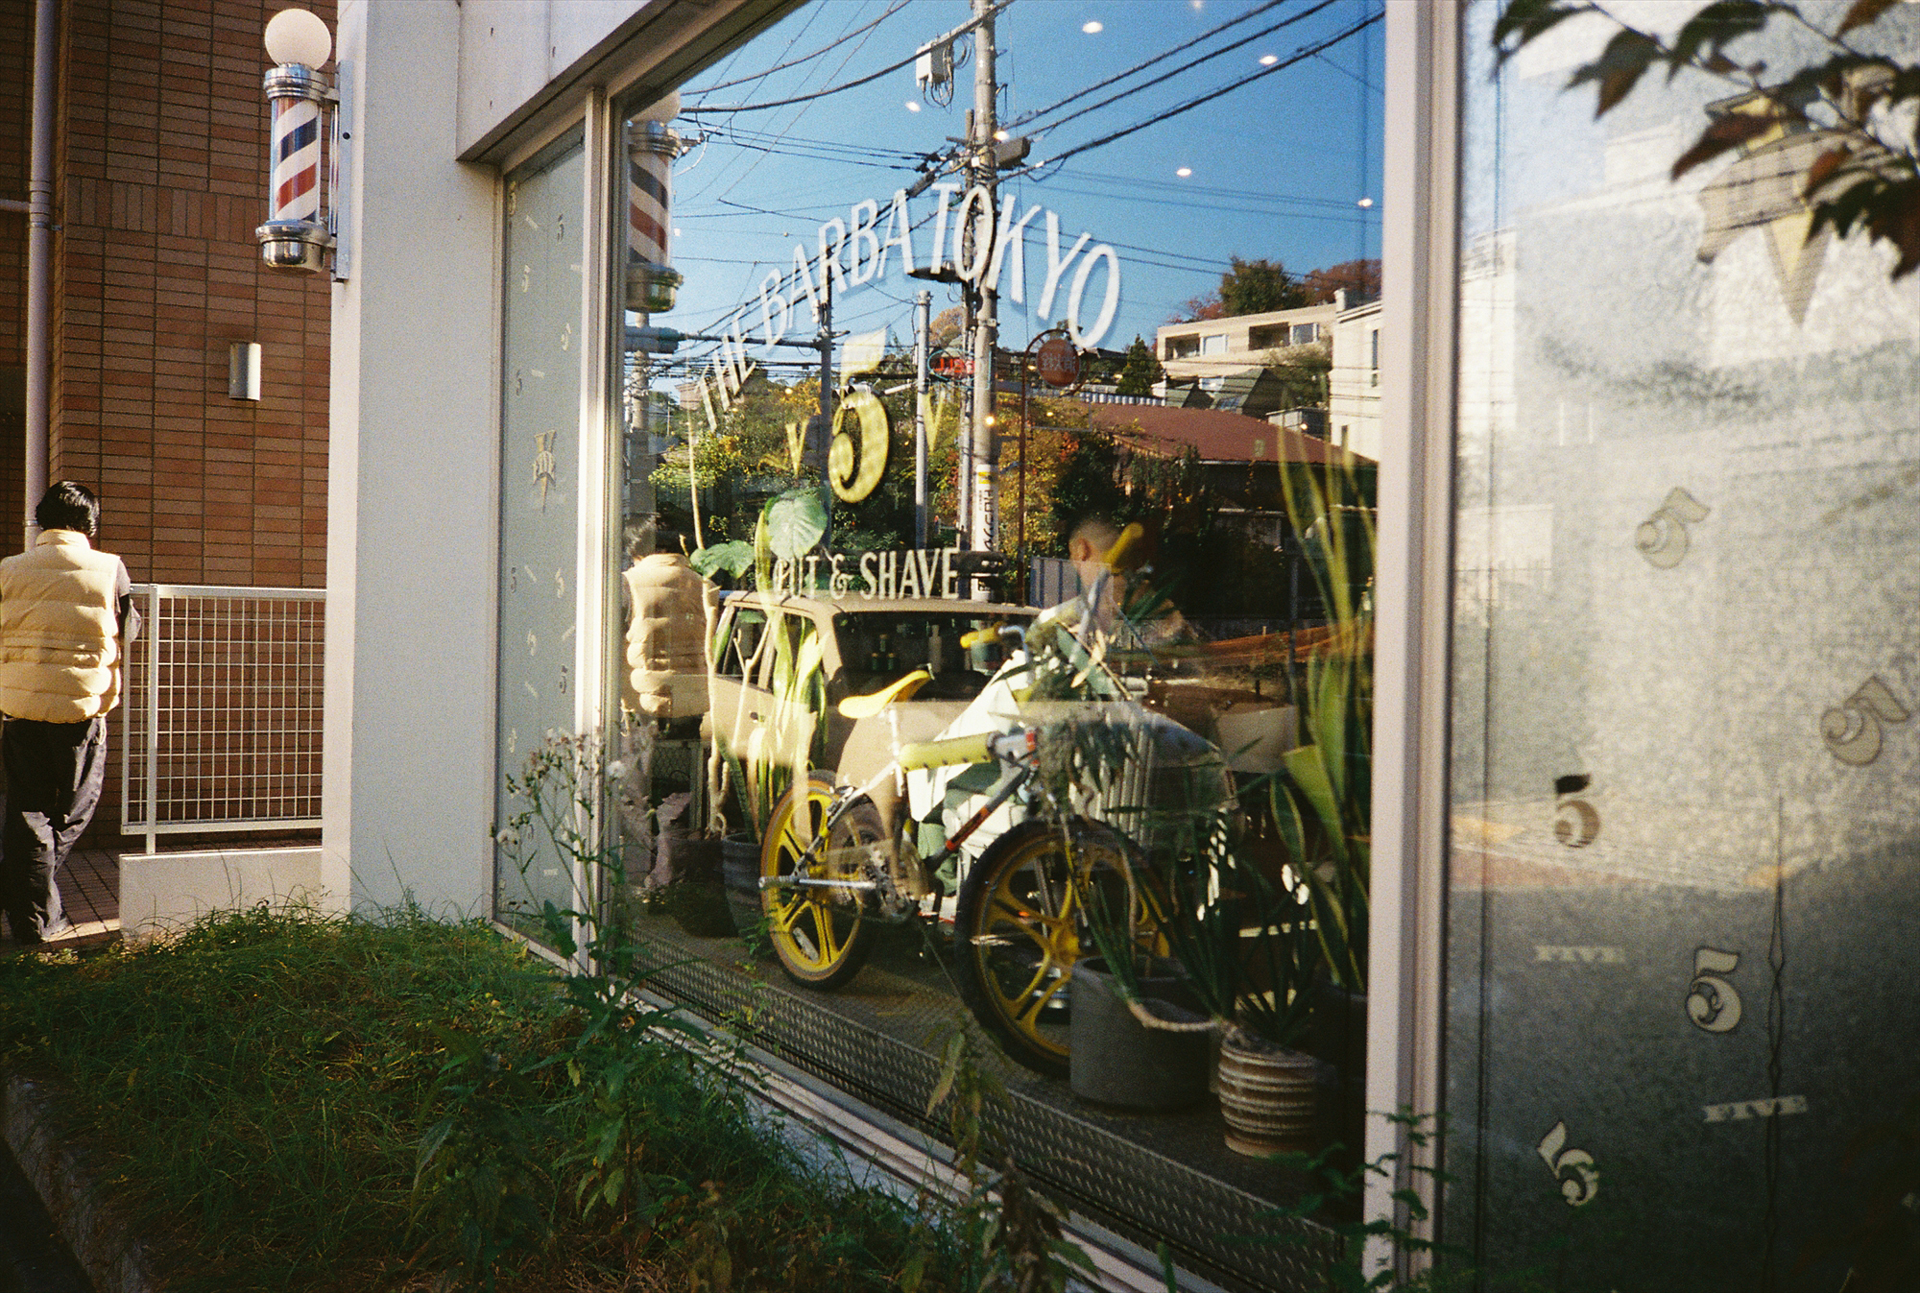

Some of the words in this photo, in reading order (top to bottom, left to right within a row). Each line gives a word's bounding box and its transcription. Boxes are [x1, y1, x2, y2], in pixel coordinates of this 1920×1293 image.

[695, 305, 757, 432] THE
[757, 189, 914, 349] BARBA
[931, 183, 1121, 349] TOKYO
[829, 553, 854, 600] &
[859, 547, 961, 600] SHAVE
[1554, 774, 1600, 849] 5
[1686, 947, 1741, 1033] 5
[1537, 1121, 1600, 1207] 5
